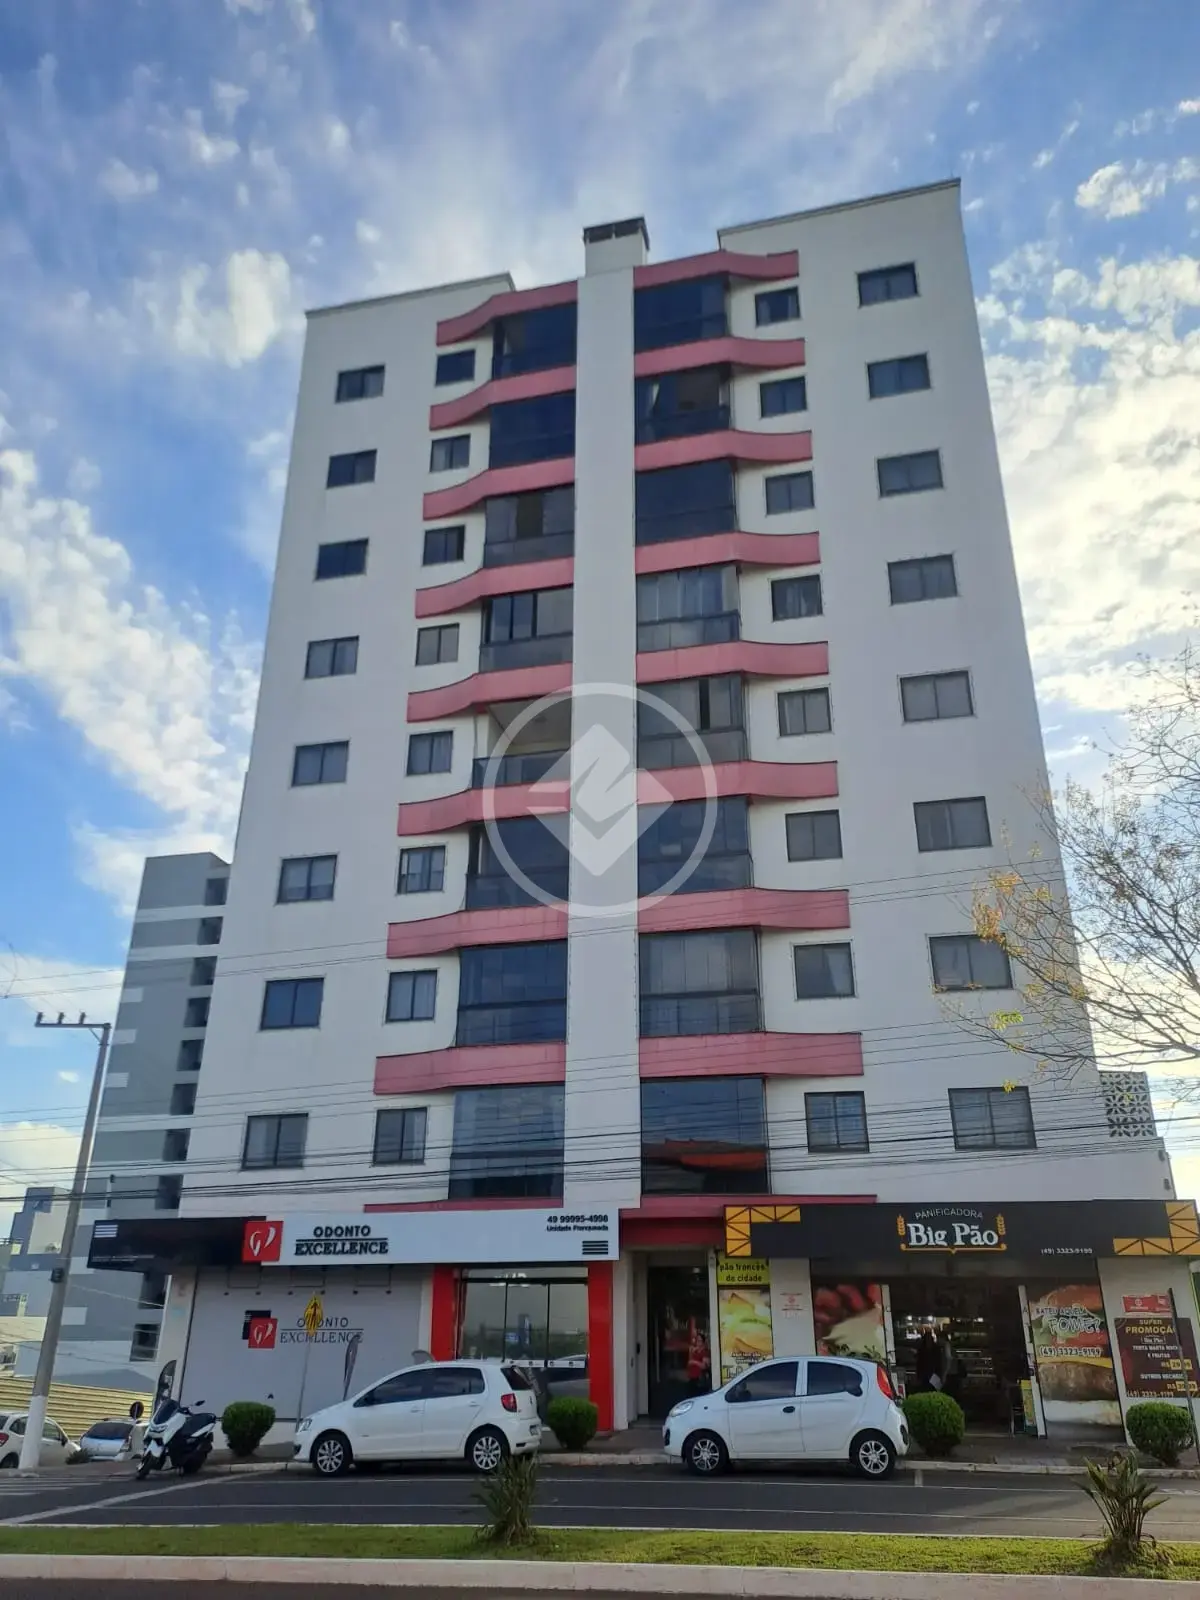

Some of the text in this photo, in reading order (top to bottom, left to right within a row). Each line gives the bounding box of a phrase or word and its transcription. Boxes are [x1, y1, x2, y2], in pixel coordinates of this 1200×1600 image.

[915, 1208, 983, 1220] PANIFICADORA
[313, 1225, 371, 1237] ODONTO
[907, 1223, 998, 1246] Big Pão
[295, 1242, 388, 1255] EXCELLENCE
[738, 1274, 762, 1282] cidade
